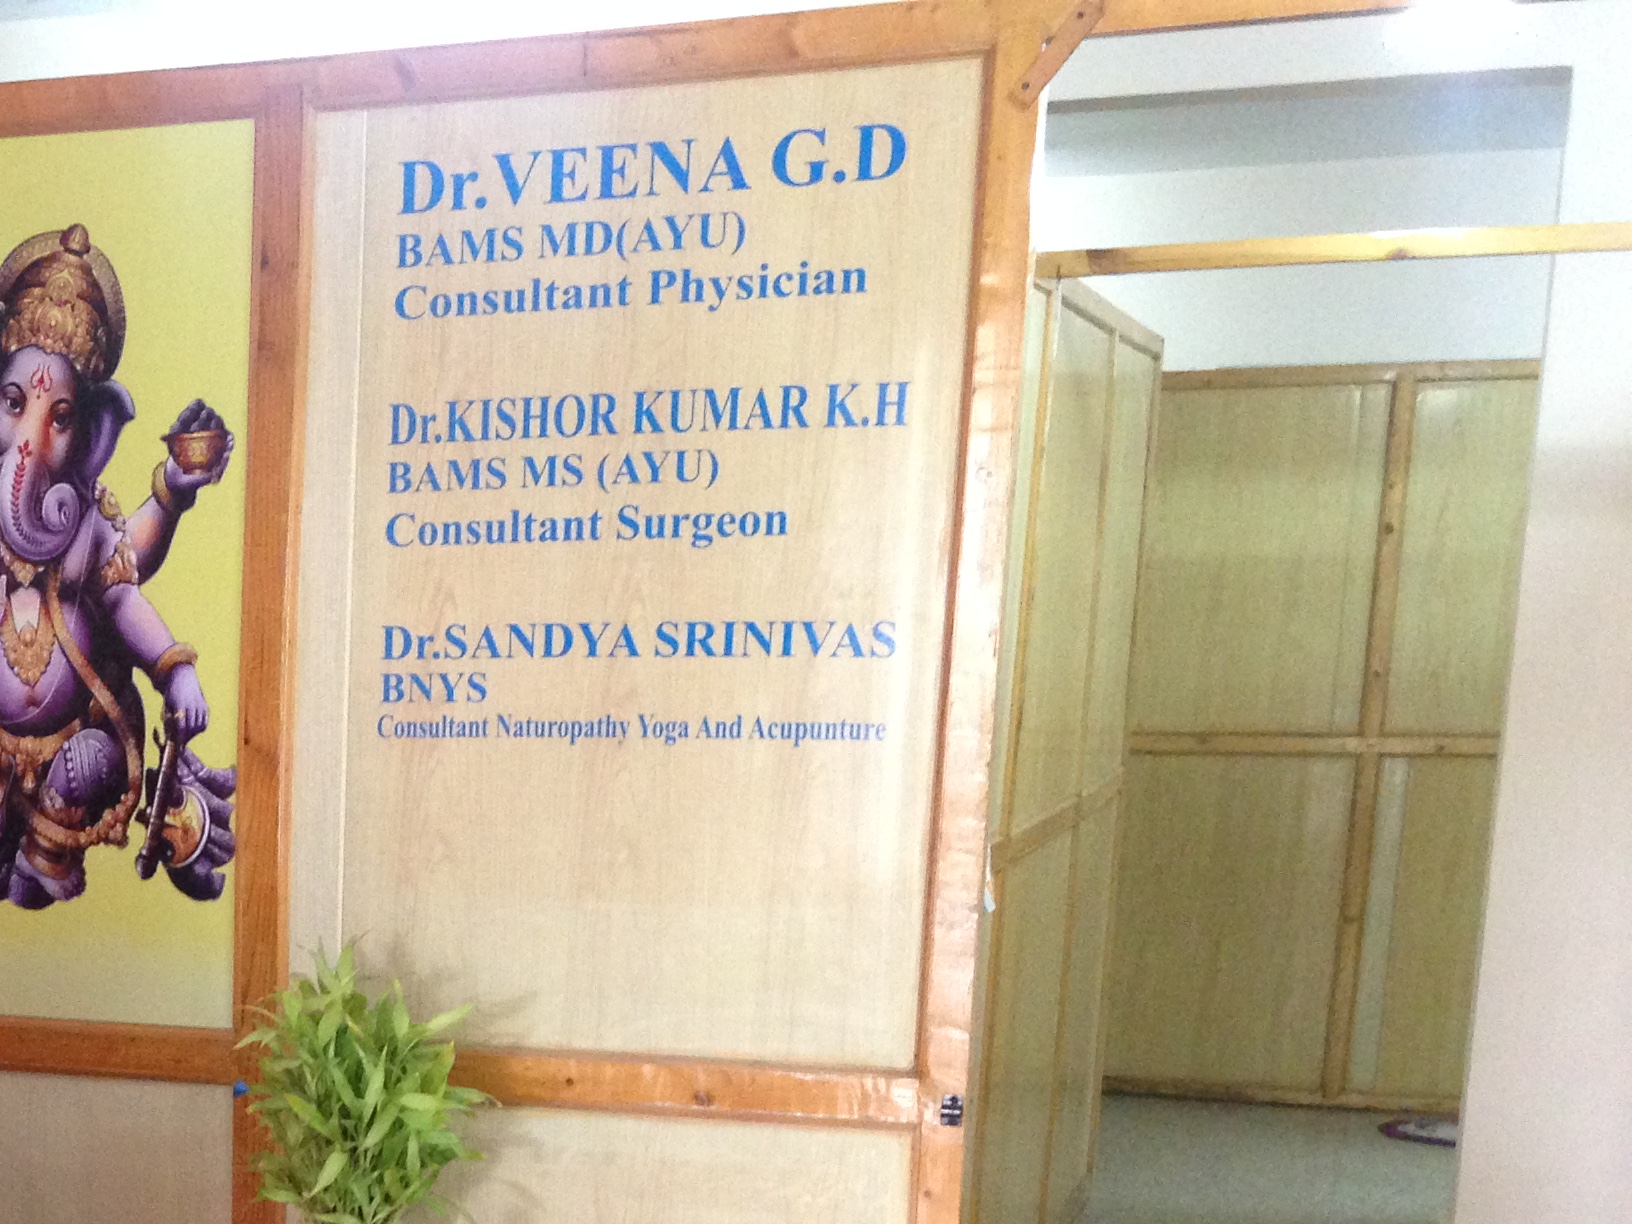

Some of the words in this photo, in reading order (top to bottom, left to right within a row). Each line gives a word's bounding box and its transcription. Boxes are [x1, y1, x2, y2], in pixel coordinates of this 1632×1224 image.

[398, 136, 752, 215] Dr.VEENA
[771, 123, 908, 188] G.D
[397, 226, 525, 268] BAMS
[539, 211, 747, 261] MD(AYU)
[394, 278, 631, 320] Consultant
[649, 261, 868, 311] Physician
[390, 389, 618, 446] Dr.KISHOR
[633, 384, 809, 434] KUMAR
[825, 381, 909, 428] K.H
[388, 458, 508, 493] BAMS
[521, 454, 585, 488] MS
[597, 449, 720, 491] (AYU)
[385, 509, 602, 547] Consultant
[616, 504, 789, 548] Surgeon
[382, 622, 641, 661] Dr.SANDYA
[654, 621, 897, 659] SRINIVAS
[381, 672, 488, 703] BNYS
[377, 713, 489, 739] Consultant
[496, 714, 631, 745] Naturopathy
[638, 714, 690, 745] Yoga
[697, 715, 743, 740] And
[753, 715, 886, 747] Acupunture
